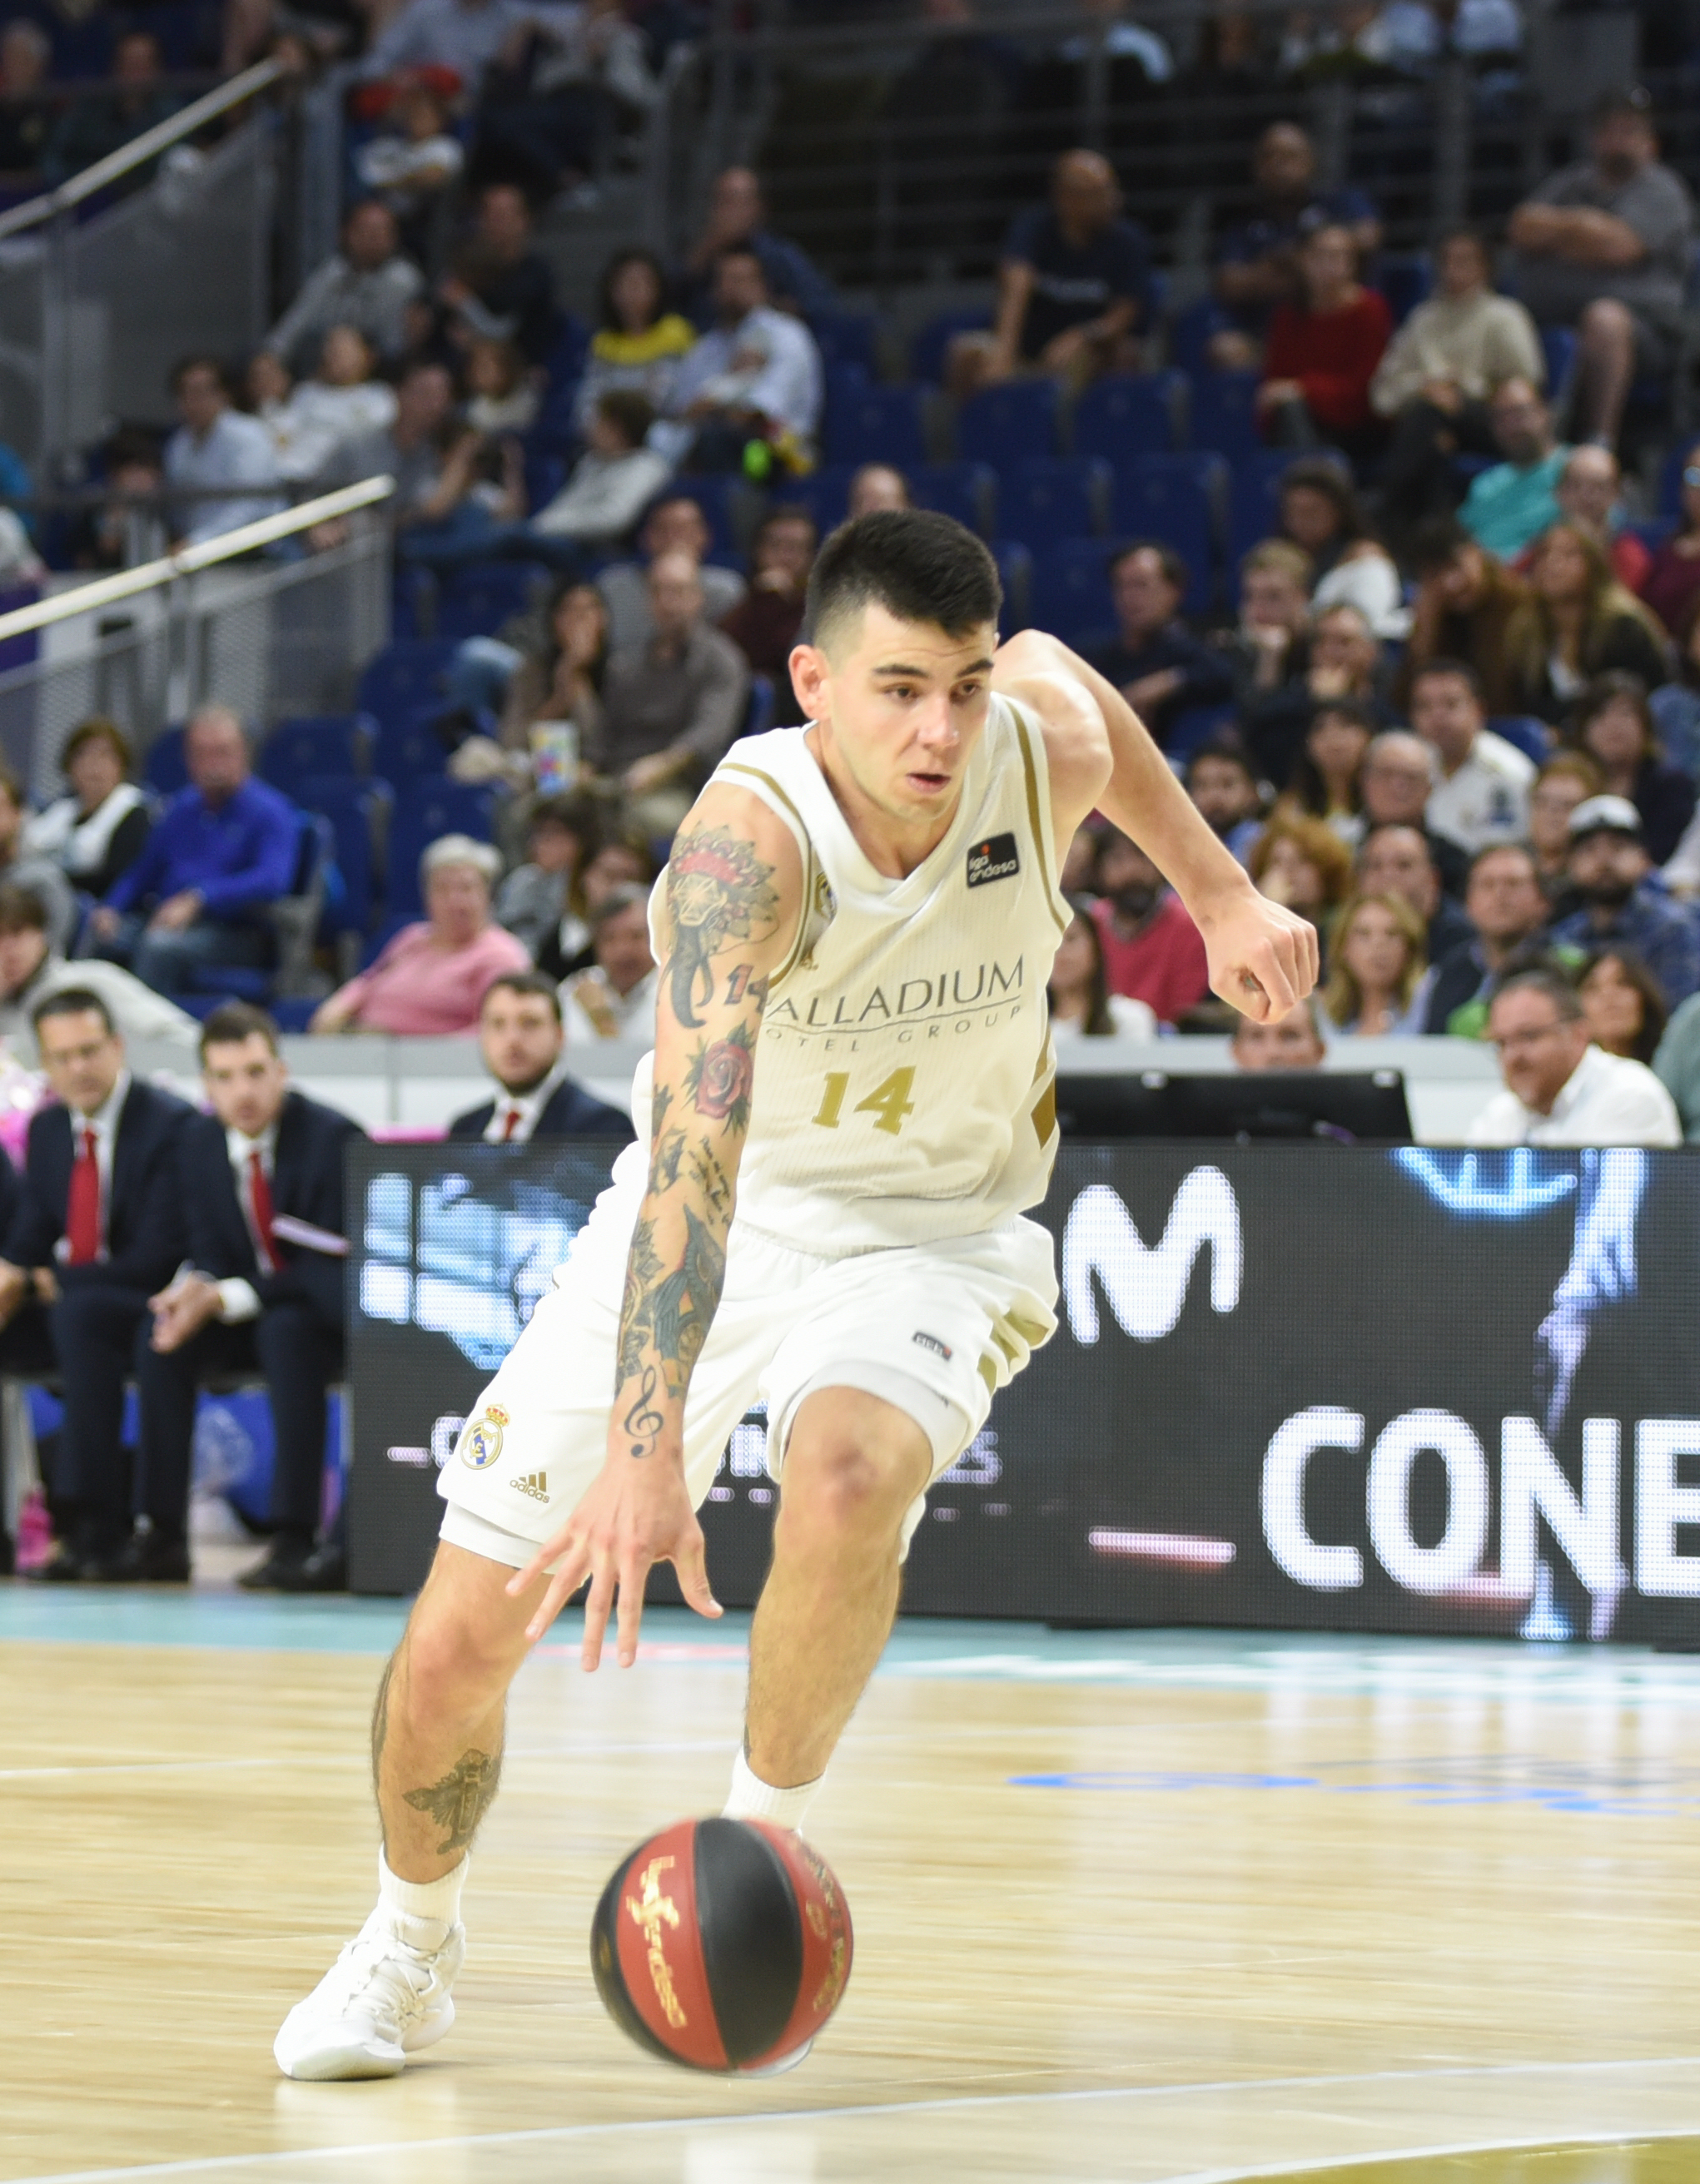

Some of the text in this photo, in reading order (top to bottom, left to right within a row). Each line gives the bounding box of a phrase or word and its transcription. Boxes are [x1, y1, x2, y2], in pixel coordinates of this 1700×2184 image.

[969, 859, 1017, 883] endesa
[764, 953, 1023, 1027] ALLADIUM
[765, 1005, 1021, 1052] OTEL GROUP
[811, 1065, 917, 1136] 14
[510, 1478, 550, 1504] adidas
